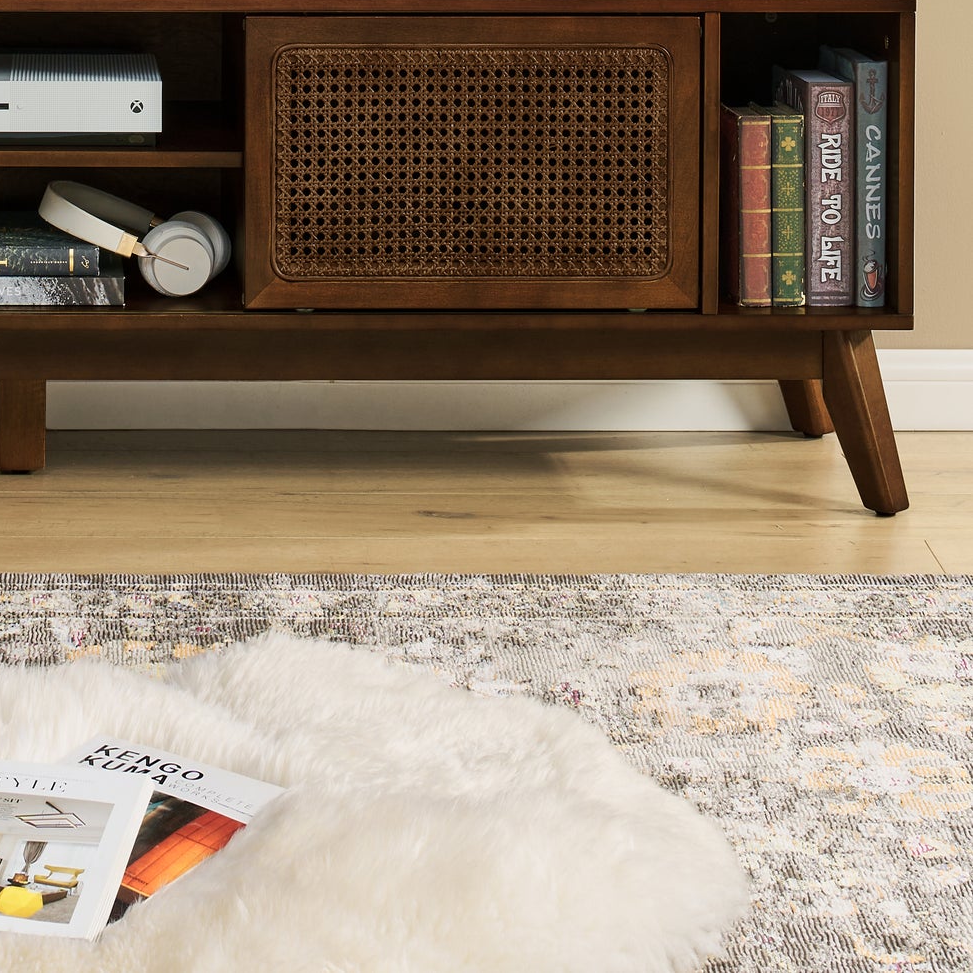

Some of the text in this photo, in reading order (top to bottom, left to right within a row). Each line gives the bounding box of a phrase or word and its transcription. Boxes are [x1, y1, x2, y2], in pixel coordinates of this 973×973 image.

[820, 94, 841, 103] ITALY
[819, 133, 843, 183] RIDE
[865, 124, 881, 239] CANNES
[820, 194, 844, 225] TO
[819, 236, 845, 284] LIFE
[78, 755, 169, 786] KUMA
[94, 744, 205, 781] KENGO
[168, 782, 219, 804] WORKS
[175, 779, 254, 810] COMPLETE
